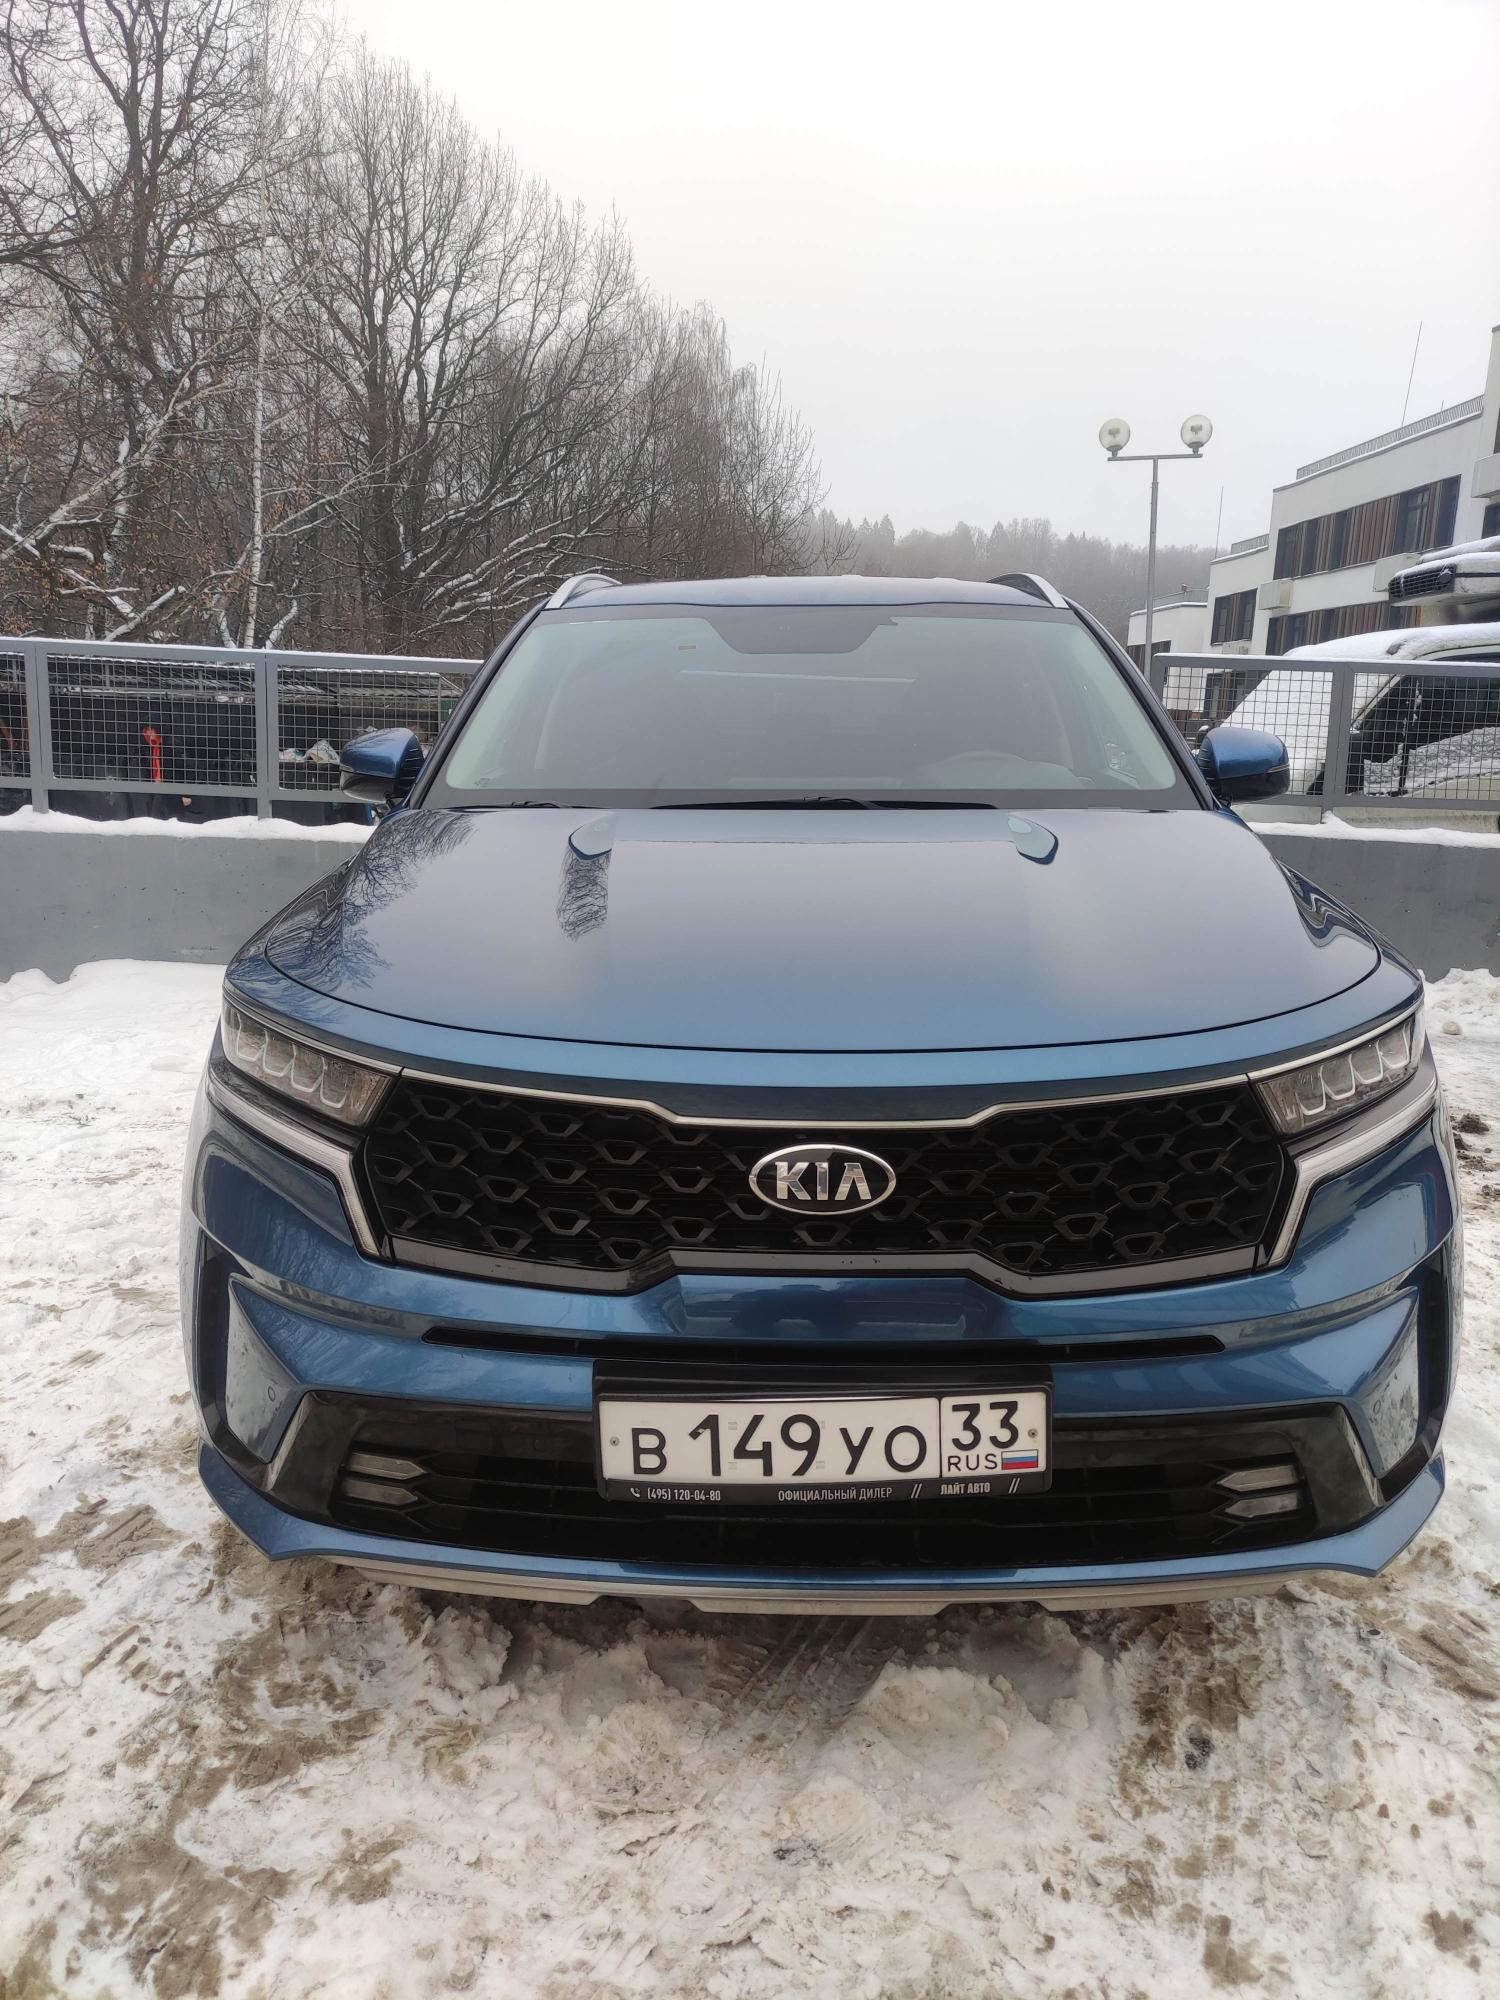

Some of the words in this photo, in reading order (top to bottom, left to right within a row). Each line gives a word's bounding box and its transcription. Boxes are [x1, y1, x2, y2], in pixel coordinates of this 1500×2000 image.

[775, 1161, 872, 1201] KIA
[951, 1400, 1019, 1451] 33
[947, 1453, 998, 1472] RUS
[647, 1487, 671, 1500] (495)
[674, 1489, 721, 1501] 120-04-80
[778, 1487, 857, 1502] ОФИЦИАЛЬНЫЙ
[859, 1487, 893, 1501] ДИЛЕР
[941, 1483, 966, 1495] ЛАЙТ
[967, 1482, 991, 1494] АВТО
